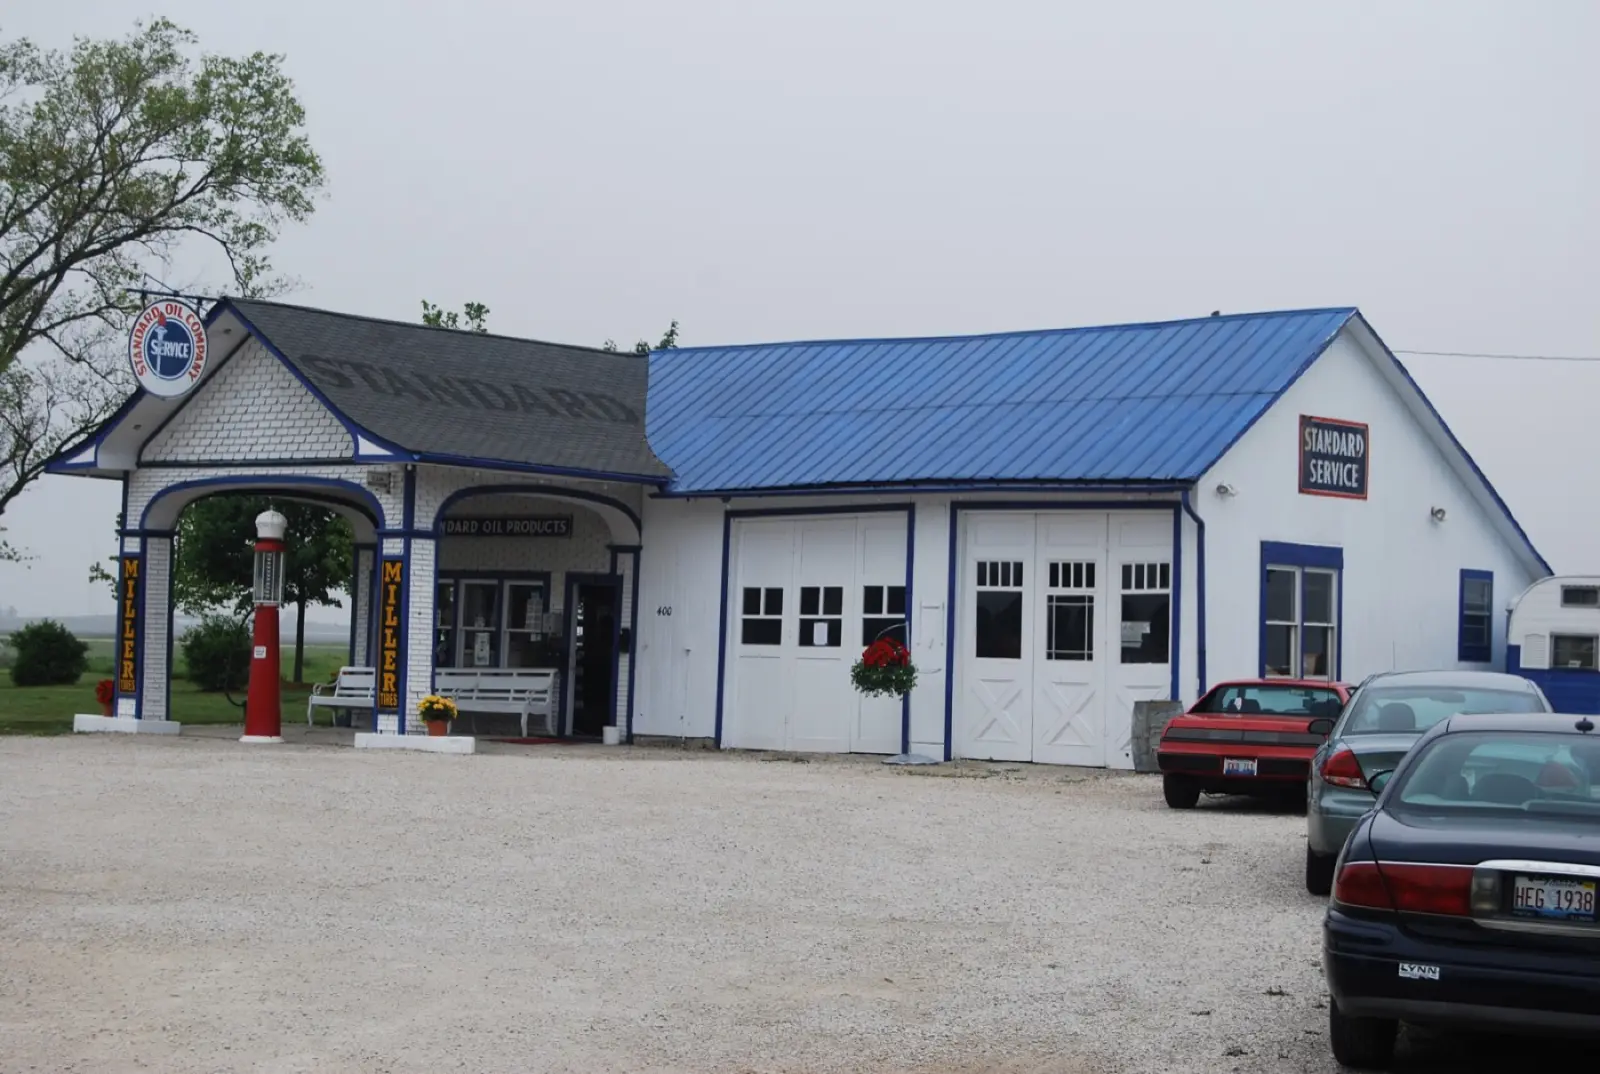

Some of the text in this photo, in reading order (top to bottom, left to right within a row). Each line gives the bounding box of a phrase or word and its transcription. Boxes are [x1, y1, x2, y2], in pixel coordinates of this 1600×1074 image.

[133, 303, 205, 382] STANDARD OIL COMPANY
[150, 339, 190, 359] SERVICE
[301, 353, 640, 425] STANDARD
[1304, 427, 1364, 457] STANDARD
[1309, 458, 1359, 488] SERVICE
[482, 519, 504, 534] OIL
[506, 519, 567, 535] PRODUCTS
[121, 559, 139, 679] MILLER
[656, 605, 673, 617] 400
[382, 561, 403, 692] MILLER
[1514, 886, 1594, 913] HEG 1938
[1400, 964, 1438, 974] LYNN
